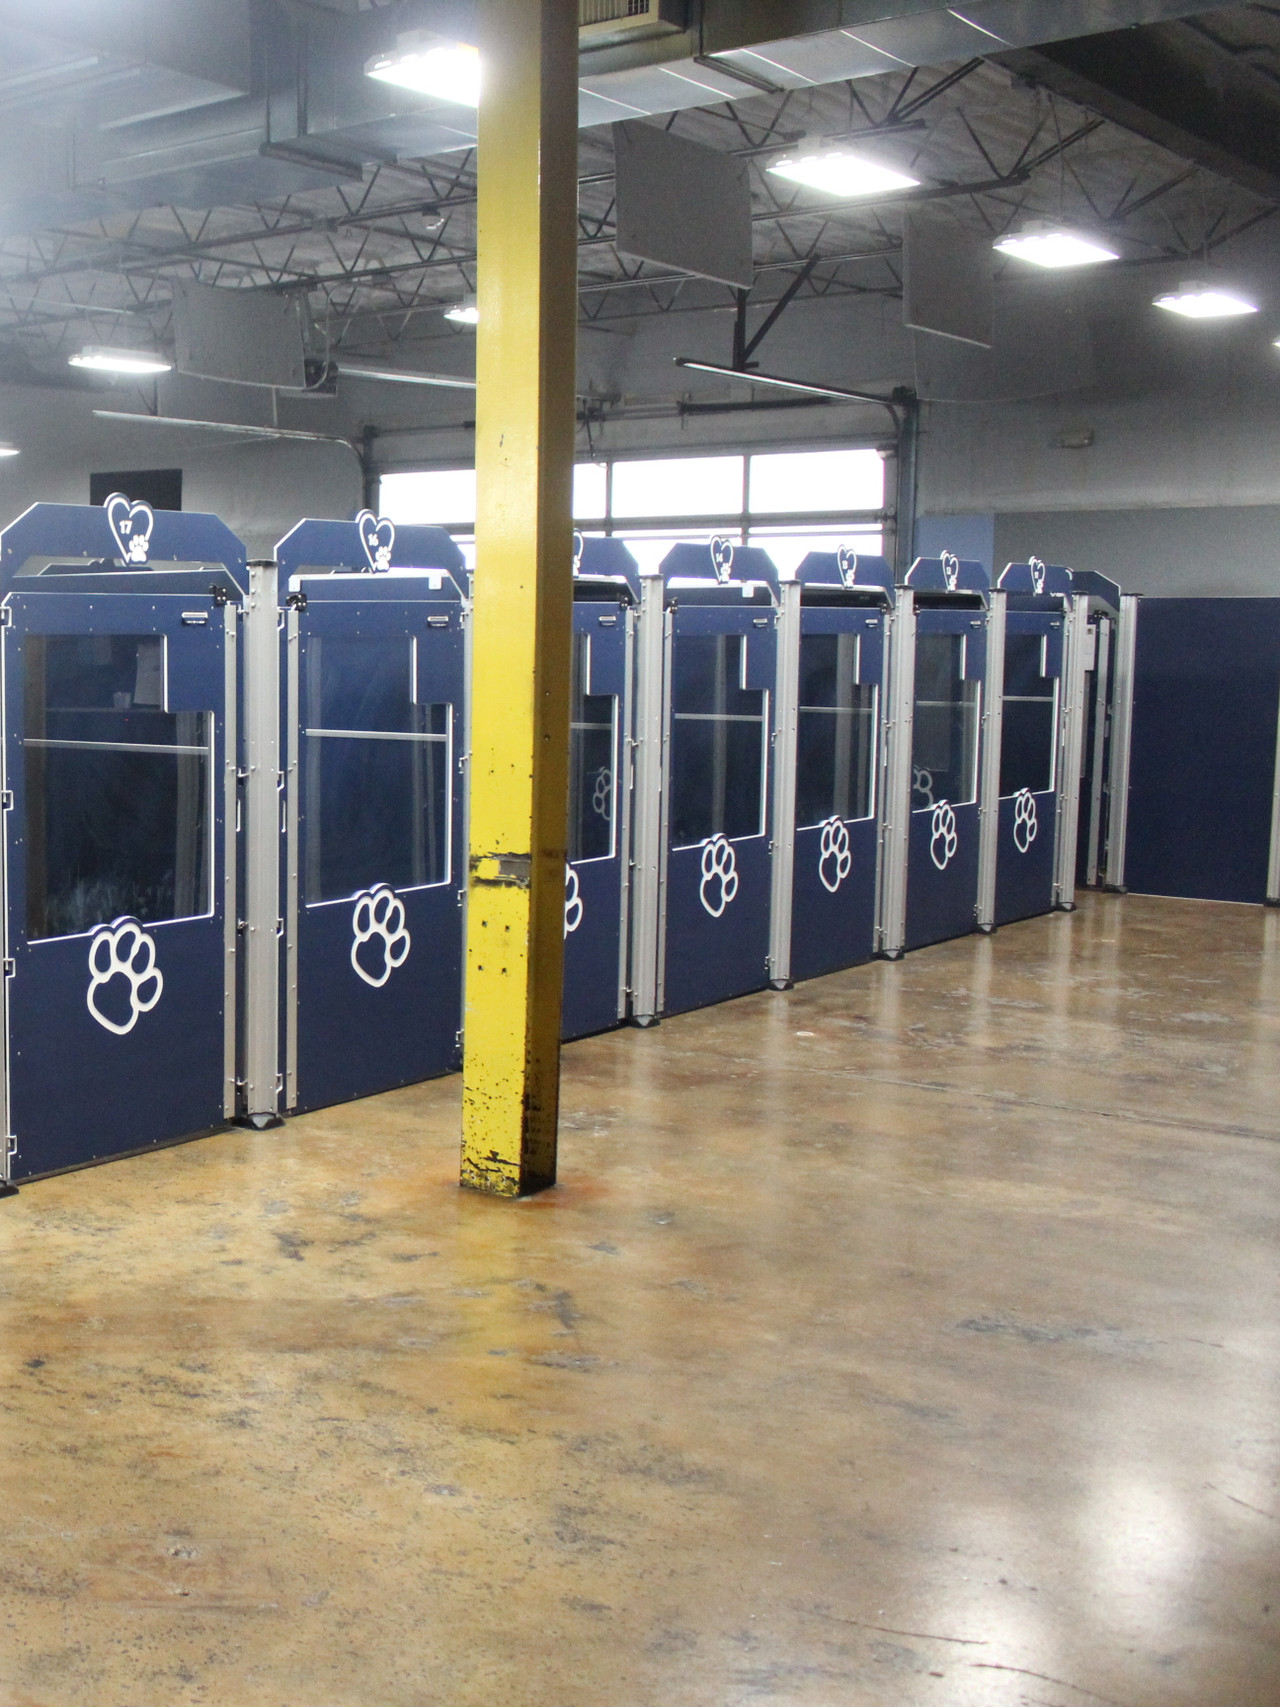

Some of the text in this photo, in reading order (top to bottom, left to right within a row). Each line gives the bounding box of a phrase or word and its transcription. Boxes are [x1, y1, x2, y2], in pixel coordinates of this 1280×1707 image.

[119, 520, 133, 534] 17
[367, 533, 379, 546] 16
[715, 553, 723, 562] 14
